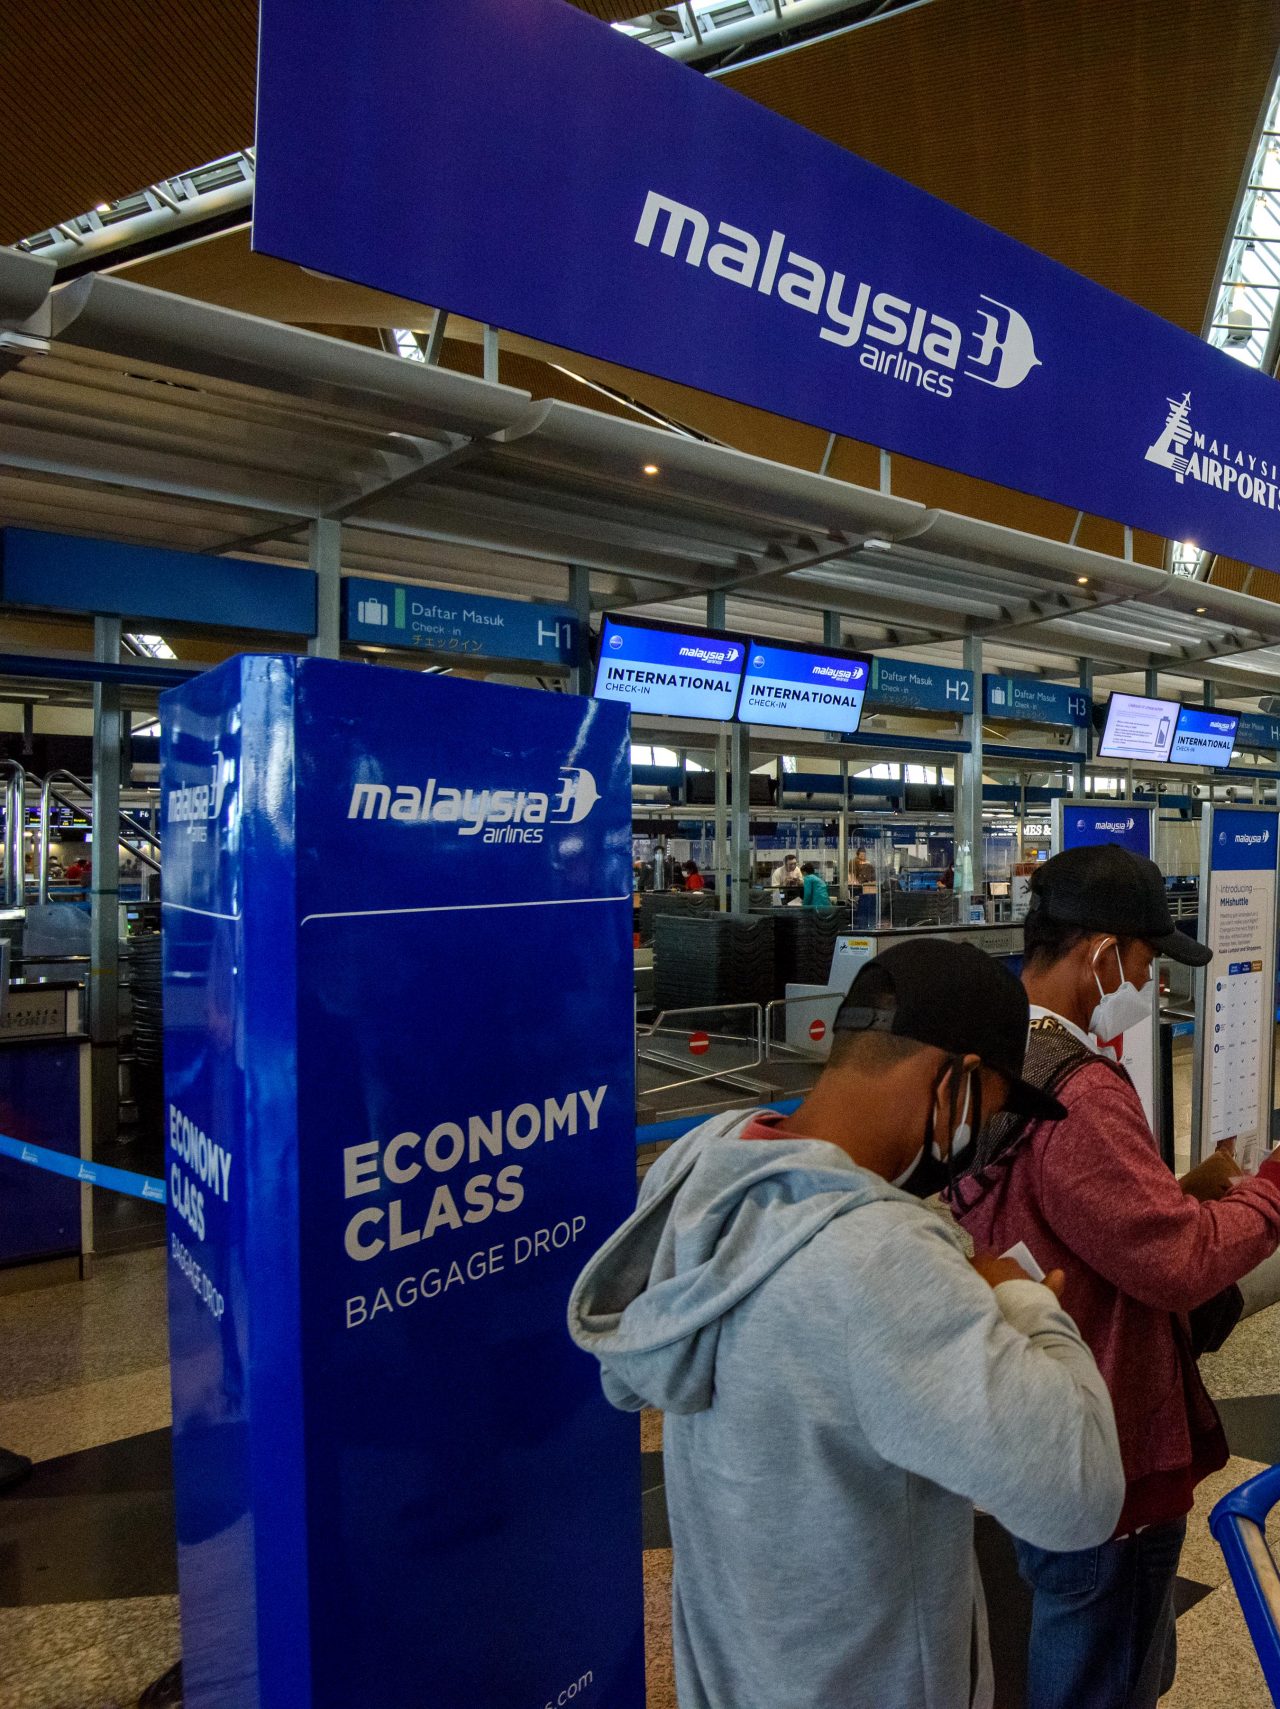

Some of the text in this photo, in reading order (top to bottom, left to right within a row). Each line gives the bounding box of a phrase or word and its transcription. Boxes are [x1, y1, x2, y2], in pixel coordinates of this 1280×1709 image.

[634, 190, 961, 369] malaysia
[860, 343, 954, 398] airlines
[411, 602, 505, 627] Daftar Masuk
[411, 635, 483, 651] チェックイン
[537, 620, 572, 650] H1
[679, 647, 725, 661] malaysia
[607, 667, 732, 693] INTERNATIONAL
[812, 666, 852, 679] malaysia
[881, 669, 933, 687] Daftar Masuk
[605, 682, 651, 695] CHECK-IN
[750, 684, 857, 708] INTERNATIONAL
[946, 679, 970, 702] H2
[1014, 688, 1056, 703] Daftar Masuk
[748, 698, 787, 709] CHECK-IN
[1068, 696, 1087, 716] H3
[1178, 736, 1231, 750] INTERNATIONAL
[348, 778, 548, 835] malaysia
[483, 825, 544, 843] airlines
[1094, 820, 1125, 833] malaysia
[1235, 833, 1261, 846] malaysia
[1220, 884, 1253, 894] Introducing
[1219, 896, 1249, 907] MHshuttle
[170, 1103, 232, 1202] ECONOMY
[343, 1085, 608, 1199] ECONOMY
[171, 1162, 206, 1242] CLASS
[344, 1164, 524, 1263] CLASS
[171, 1232, 225, 1312] BAGGAGE DROP
[346, 1214, 587, 1329] BAGGAGE DROP
